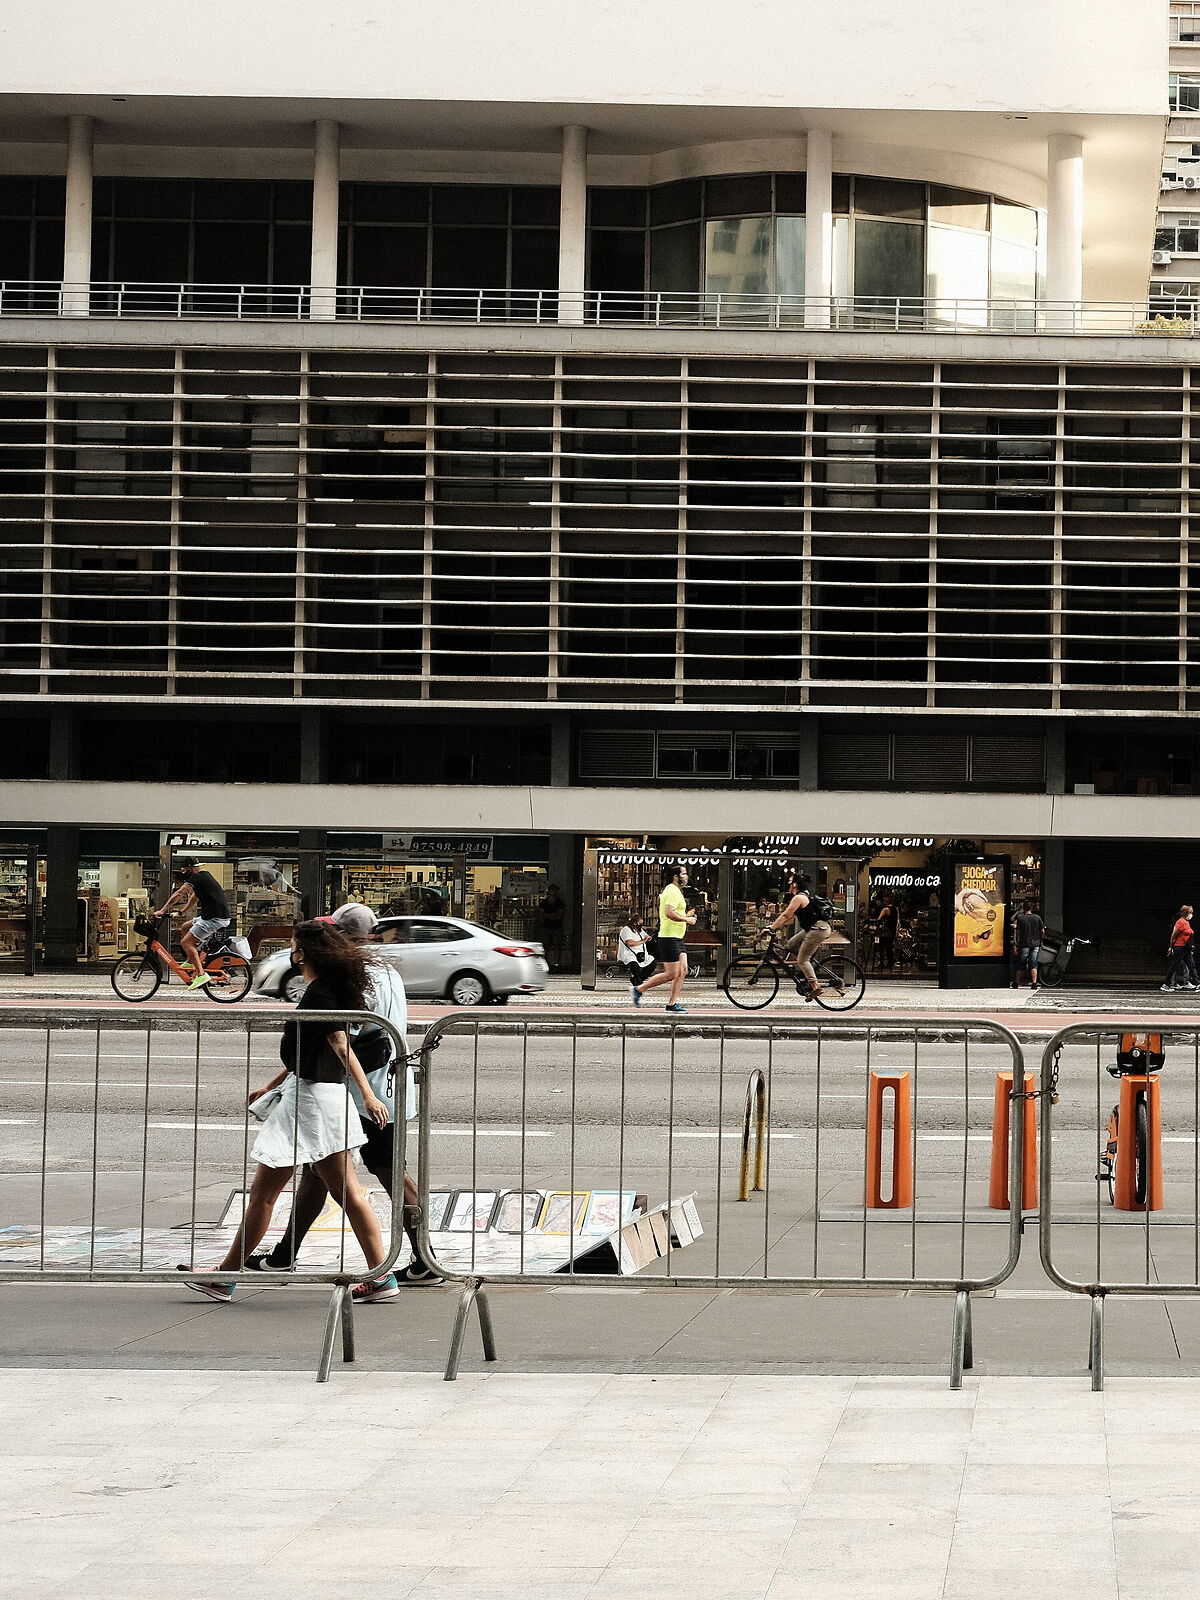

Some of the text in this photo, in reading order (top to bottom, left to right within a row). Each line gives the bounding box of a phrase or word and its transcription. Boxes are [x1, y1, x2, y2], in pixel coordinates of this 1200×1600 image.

[412, 842, 489, 852] 97598-4849
[965, 866, 987, 879] JOGA
[874, 873, 914, 887] mundo
[914, 876, 925, 887] do
[961, 879, 997, 891] CHEDDAR
